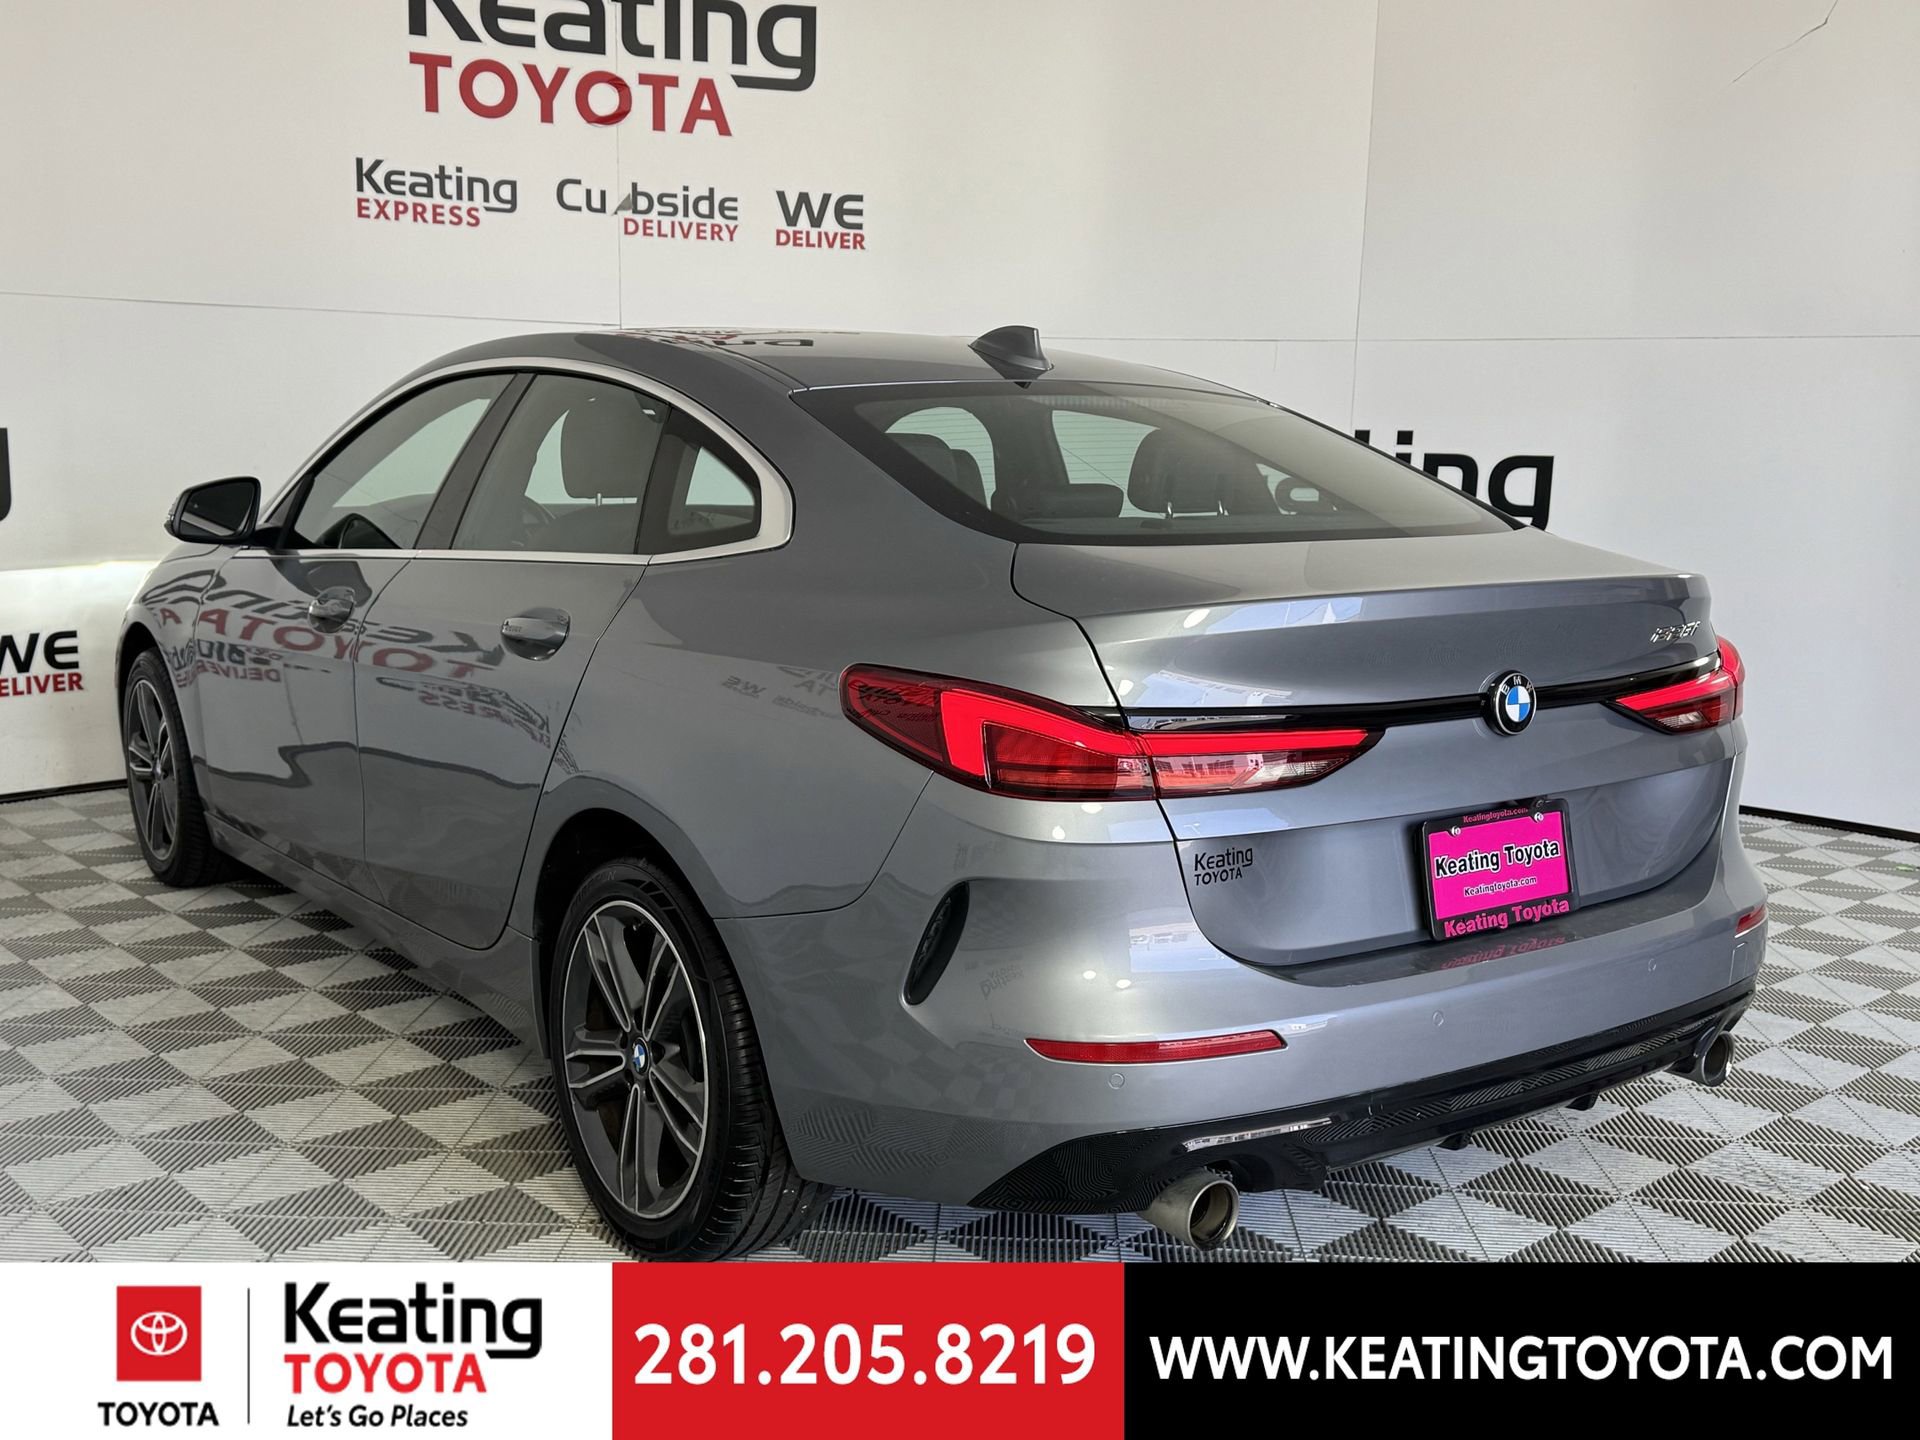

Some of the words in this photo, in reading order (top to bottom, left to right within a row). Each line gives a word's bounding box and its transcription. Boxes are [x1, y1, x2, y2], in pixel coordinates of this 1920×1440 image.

[409, 52, 730, 136] TOYOTA
[355, 157, 517, 213] Keating
[556, 178, 738, 221] Cubside
[357, 198, 480, 228] EXPRESS
[775, 190, 864, 230] WE
[623, 217, 739, 242] DELIVERY
[776, 229, 866, 250] DELIVER
[1500, 674, 1533, 696] BMW
[1194, 847, 1253, 871] Keating
[1435, 850, 1500, 878] Keating
[1504, 838, 1560, 866] Toyota
[1194, 866, 1243, 886] TOYOTA
[1463, 876, 1537, 898] Keatingtoyota.com
[1443, 911, 1509, 938] Keating
[1511, 898, 1570, 923] Toyota
